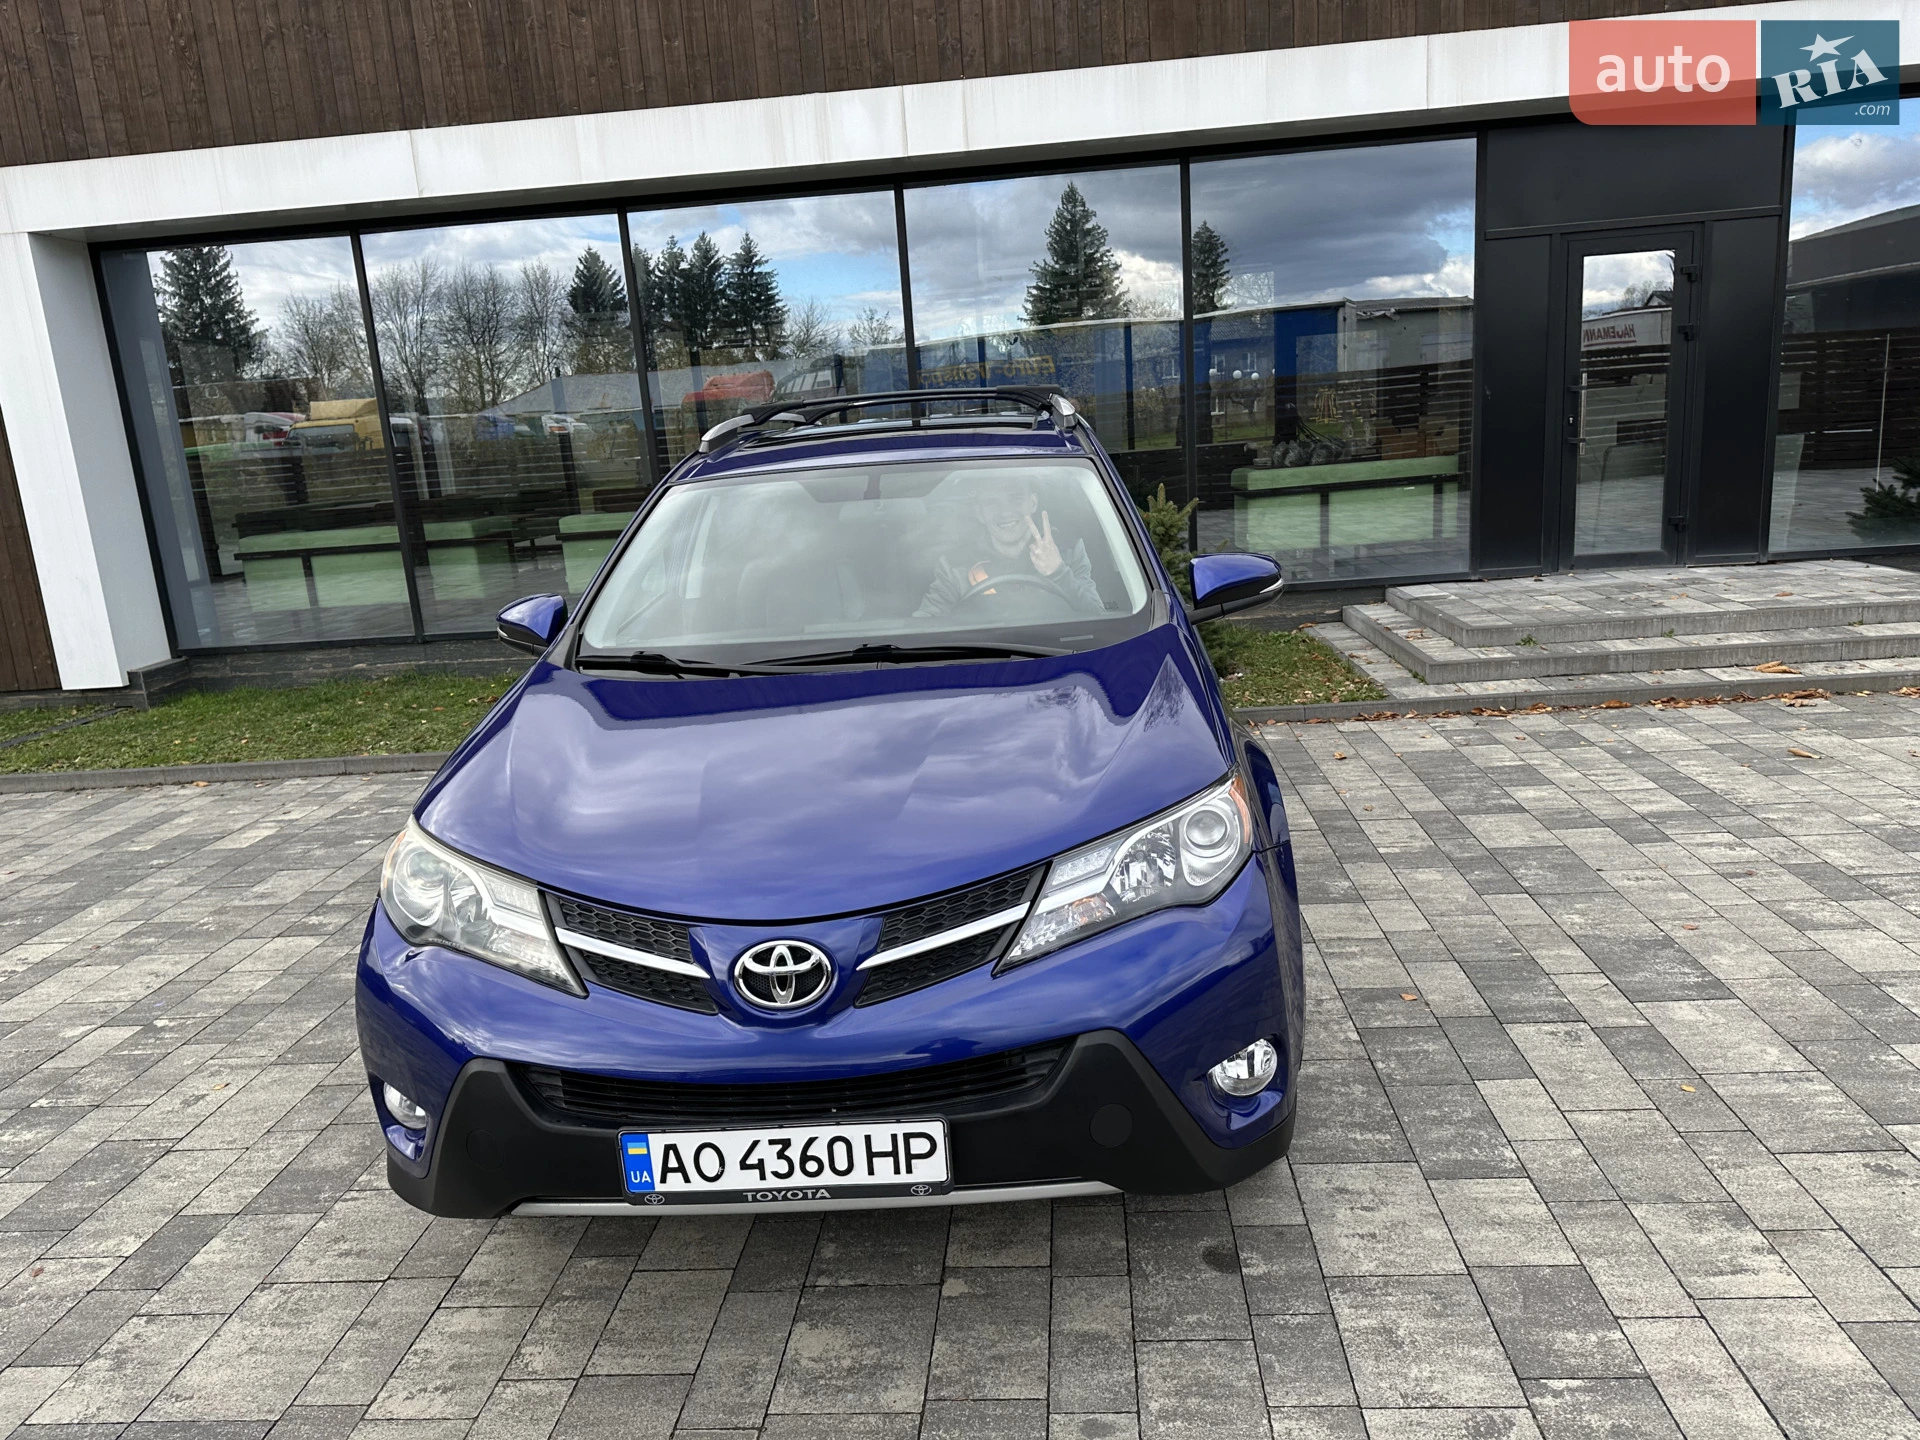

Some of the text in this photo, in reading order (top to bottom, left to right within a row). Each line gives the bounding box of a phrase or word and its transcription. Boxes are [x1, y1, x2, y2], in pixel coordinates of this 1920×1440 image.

[660, 1131, 938, 1184] AO 4360 HP
[631, 1170, 651, 1183] UA
[743, 1188, 832, 1202] TOYOTA
